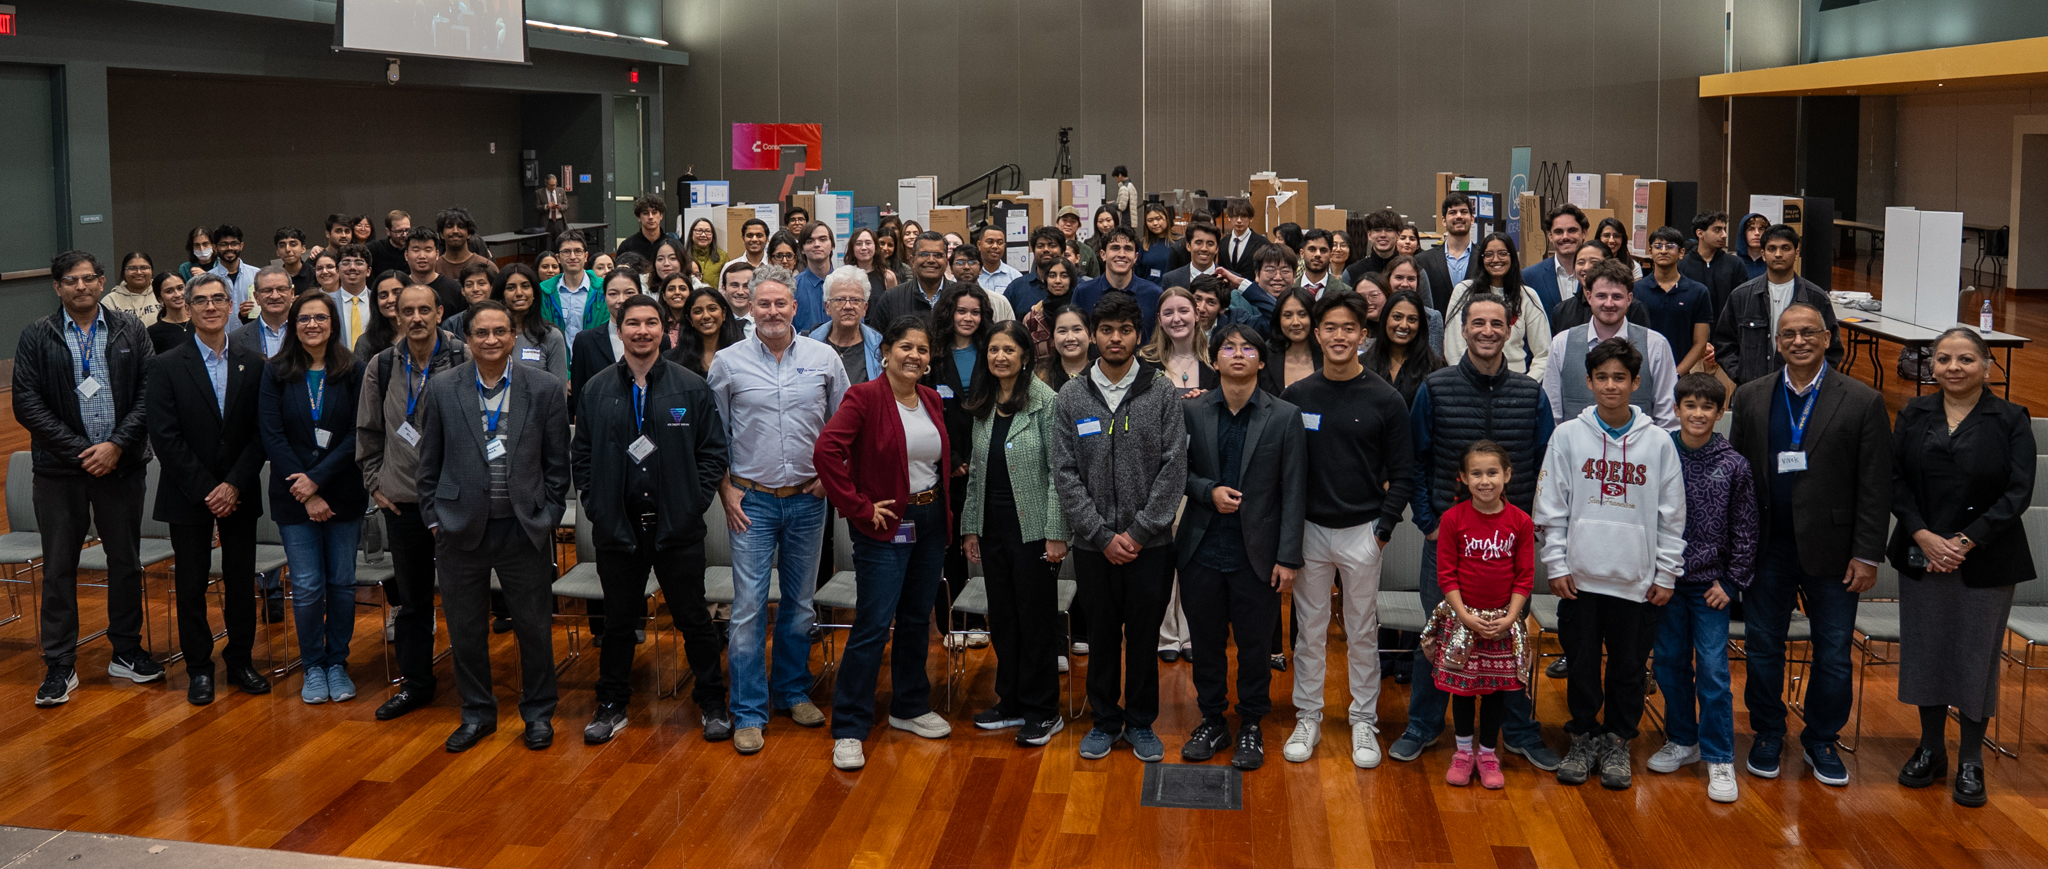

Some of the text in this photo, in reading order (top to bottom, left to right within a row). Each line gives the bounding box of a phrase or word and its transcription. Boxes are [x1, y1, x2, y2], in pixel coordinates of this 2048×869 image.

[0, 14, 11, 34] XIT
[1581, 457, 1647, 486] 49ERS
[1463, 529, 1516, 561] joyful
